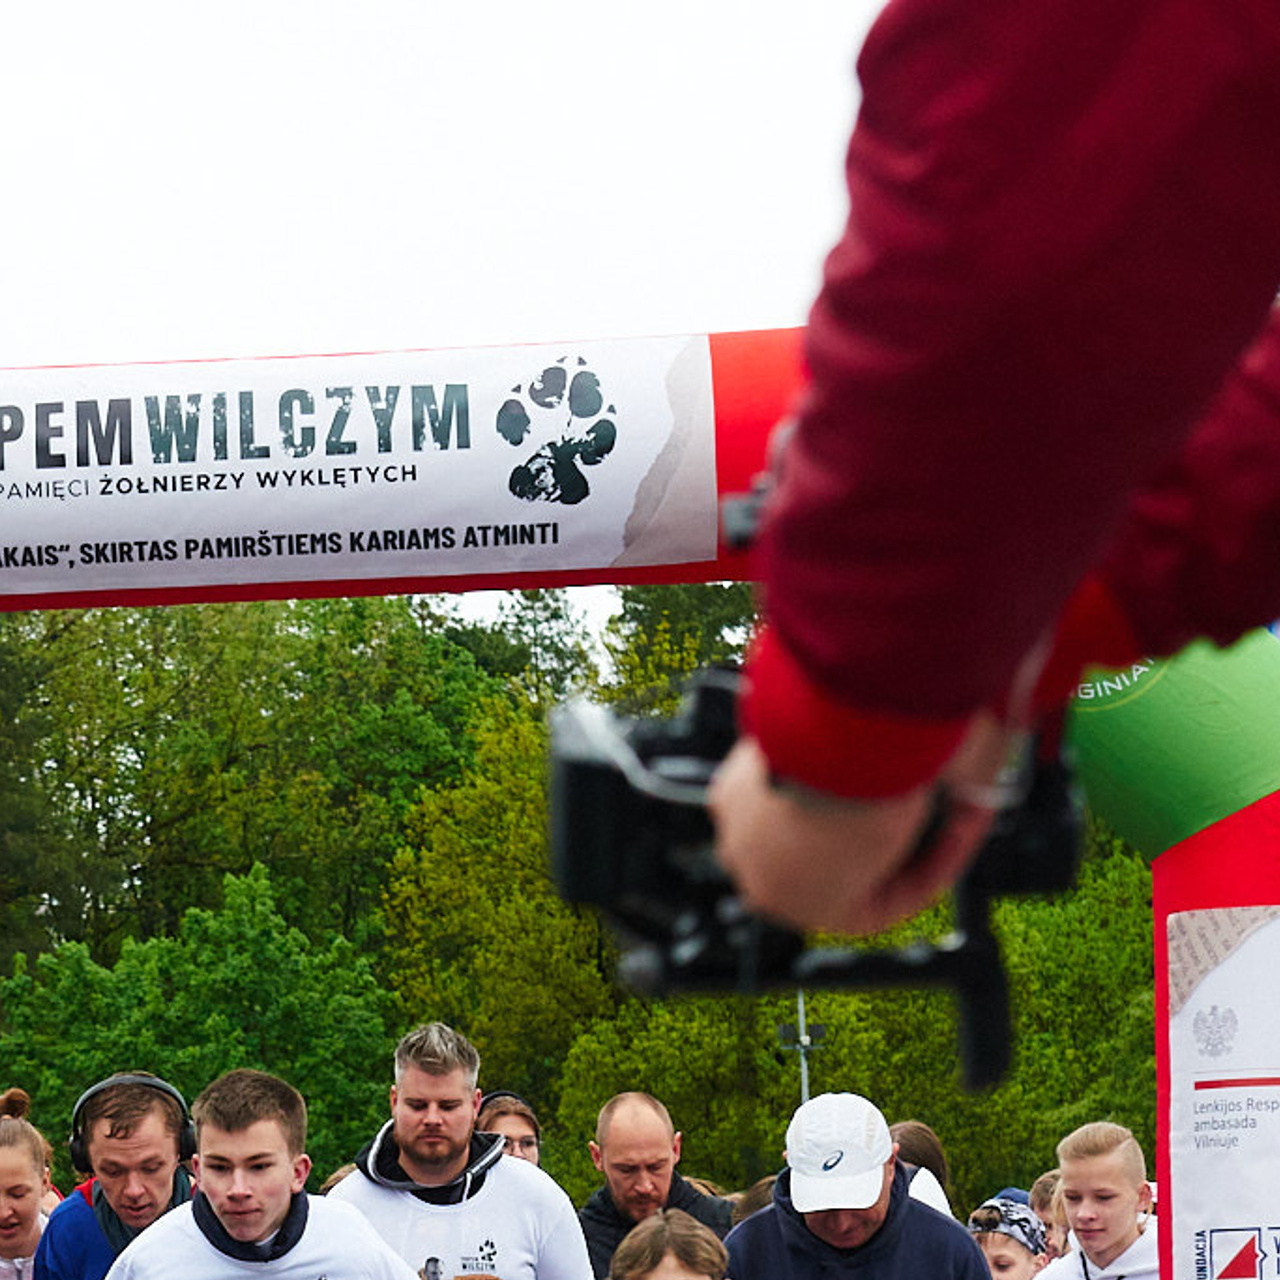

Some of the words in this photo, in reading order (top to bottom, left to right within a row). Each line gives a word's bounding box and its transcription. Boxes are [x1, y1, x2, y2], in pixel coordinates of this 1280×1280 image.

[99, 472, 245, 495] ŻOŁNIERZY
[256, 464, 418, 489] WYKLĘTYCH
[79, 539, 177, 564] SKIRTAS
[185, 531, 342, 560] PAMIRŠTIEMS
[350, 525, 455, 552] KARIAMS
[463, 522, 559, 548] ATMINTI
[1193, 1099, 1242, 1116] Lenkijos
[1194, 1114, 1258, 1132] ambasada
[1194, 1133, 1240, 1149] Vilniuje
